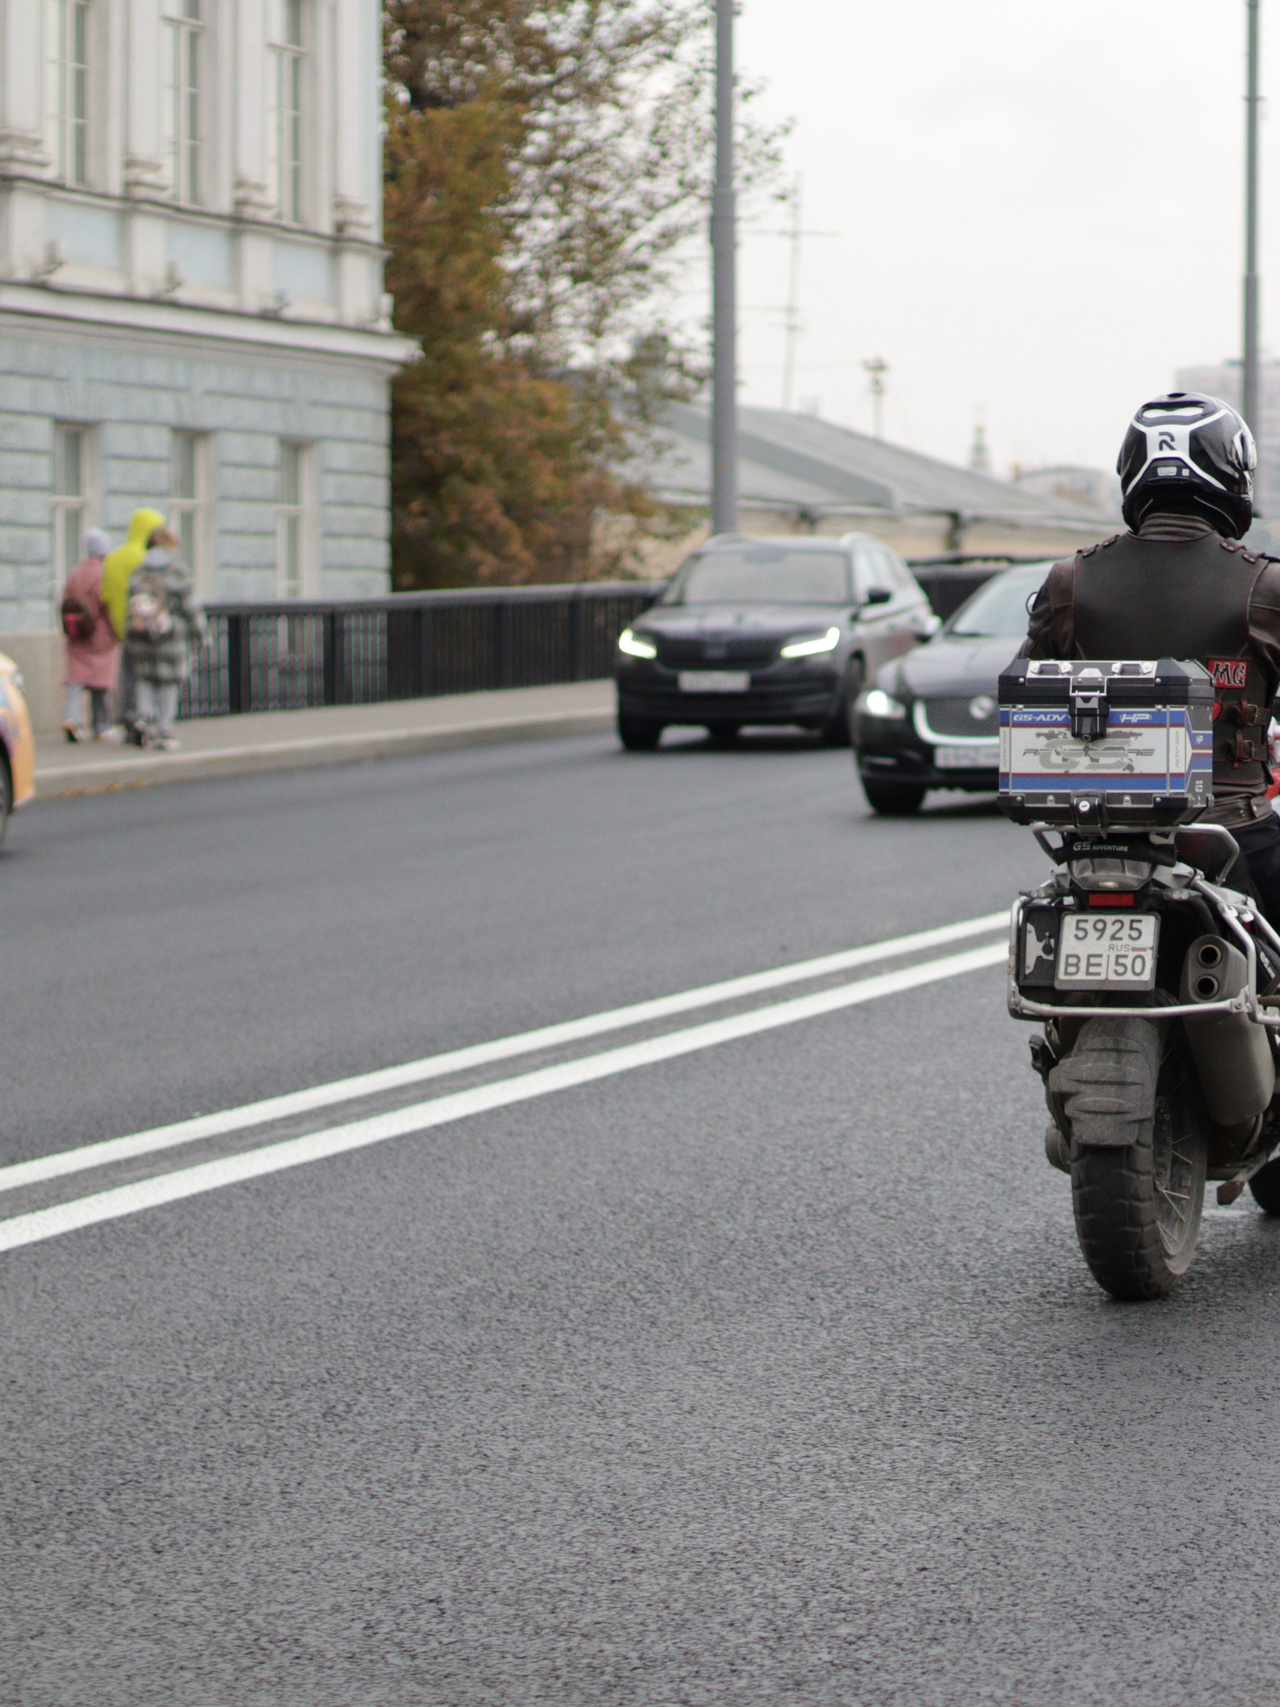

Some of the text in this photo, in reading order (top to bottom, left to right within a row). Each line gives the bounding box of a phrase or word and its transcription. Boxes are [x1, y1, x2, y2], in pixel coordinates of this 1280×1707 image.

[1013, 714, 1066, 722] GS-ADV
[1120, 713, 1151, 723] HP
[1073, 841, 1091, 850] GS
[1073, 918, 1143, 941] 5925
[1108, 944, 1131, 952] RUS
[1064, 953, 1146, 977] BE 50
